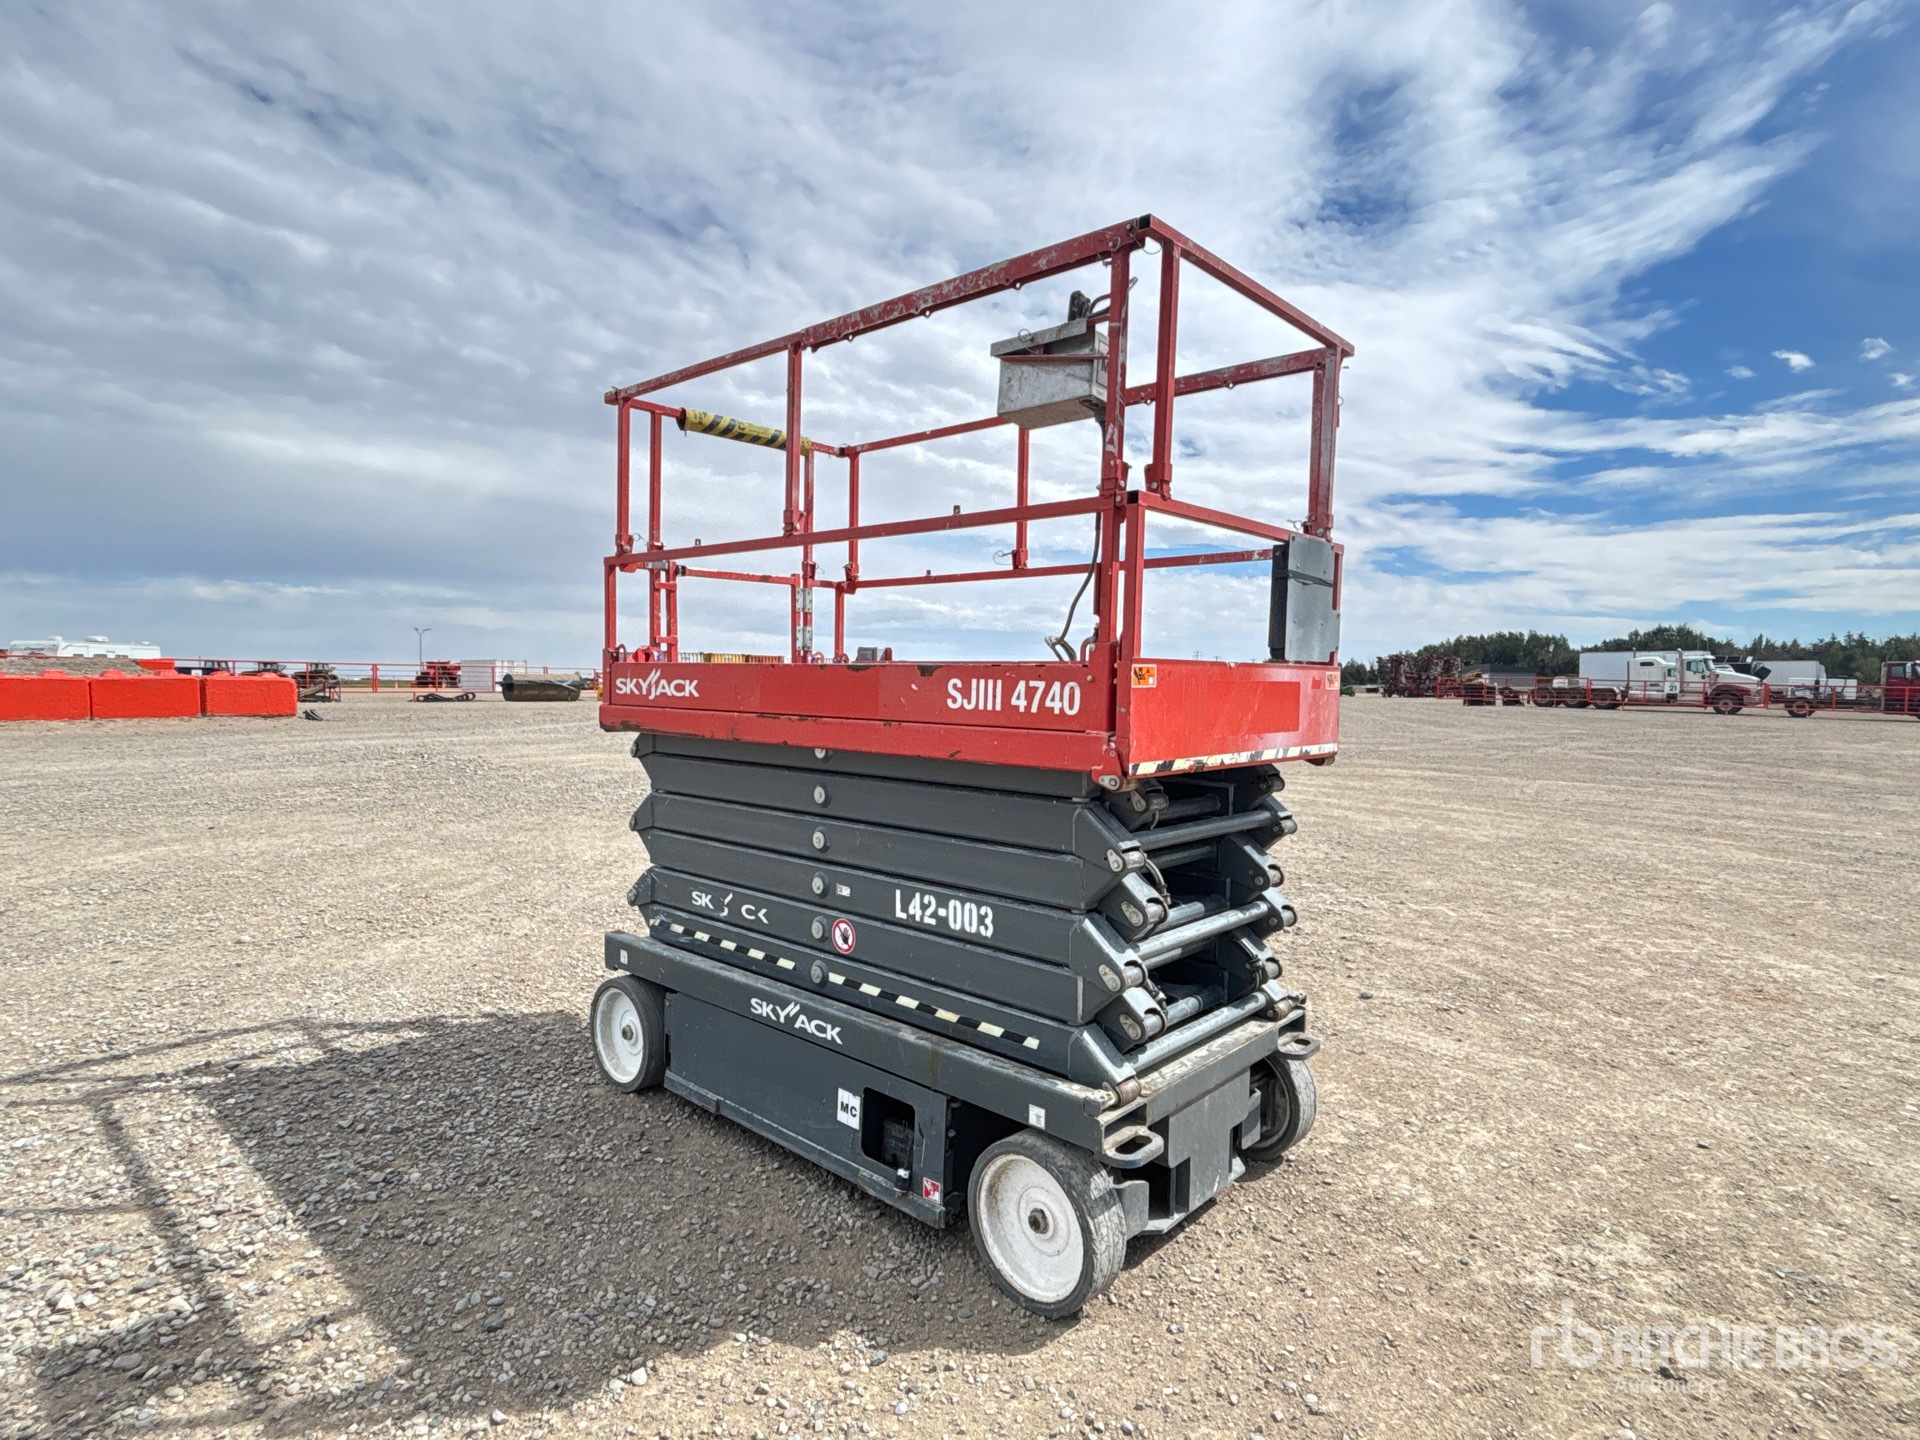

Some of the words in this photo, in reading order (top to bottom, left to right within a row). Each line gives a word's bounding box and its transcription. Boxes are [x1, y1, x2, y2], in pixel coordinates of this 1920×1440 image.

[615, 668, 700, 700] SKYJACK
[946, 677, 1003, 712] SJIII
[1010, 679, 1081, 716] 4740
[895, 888, 994, 939] L42-003
[840, 1101, 858, 1118] MC
